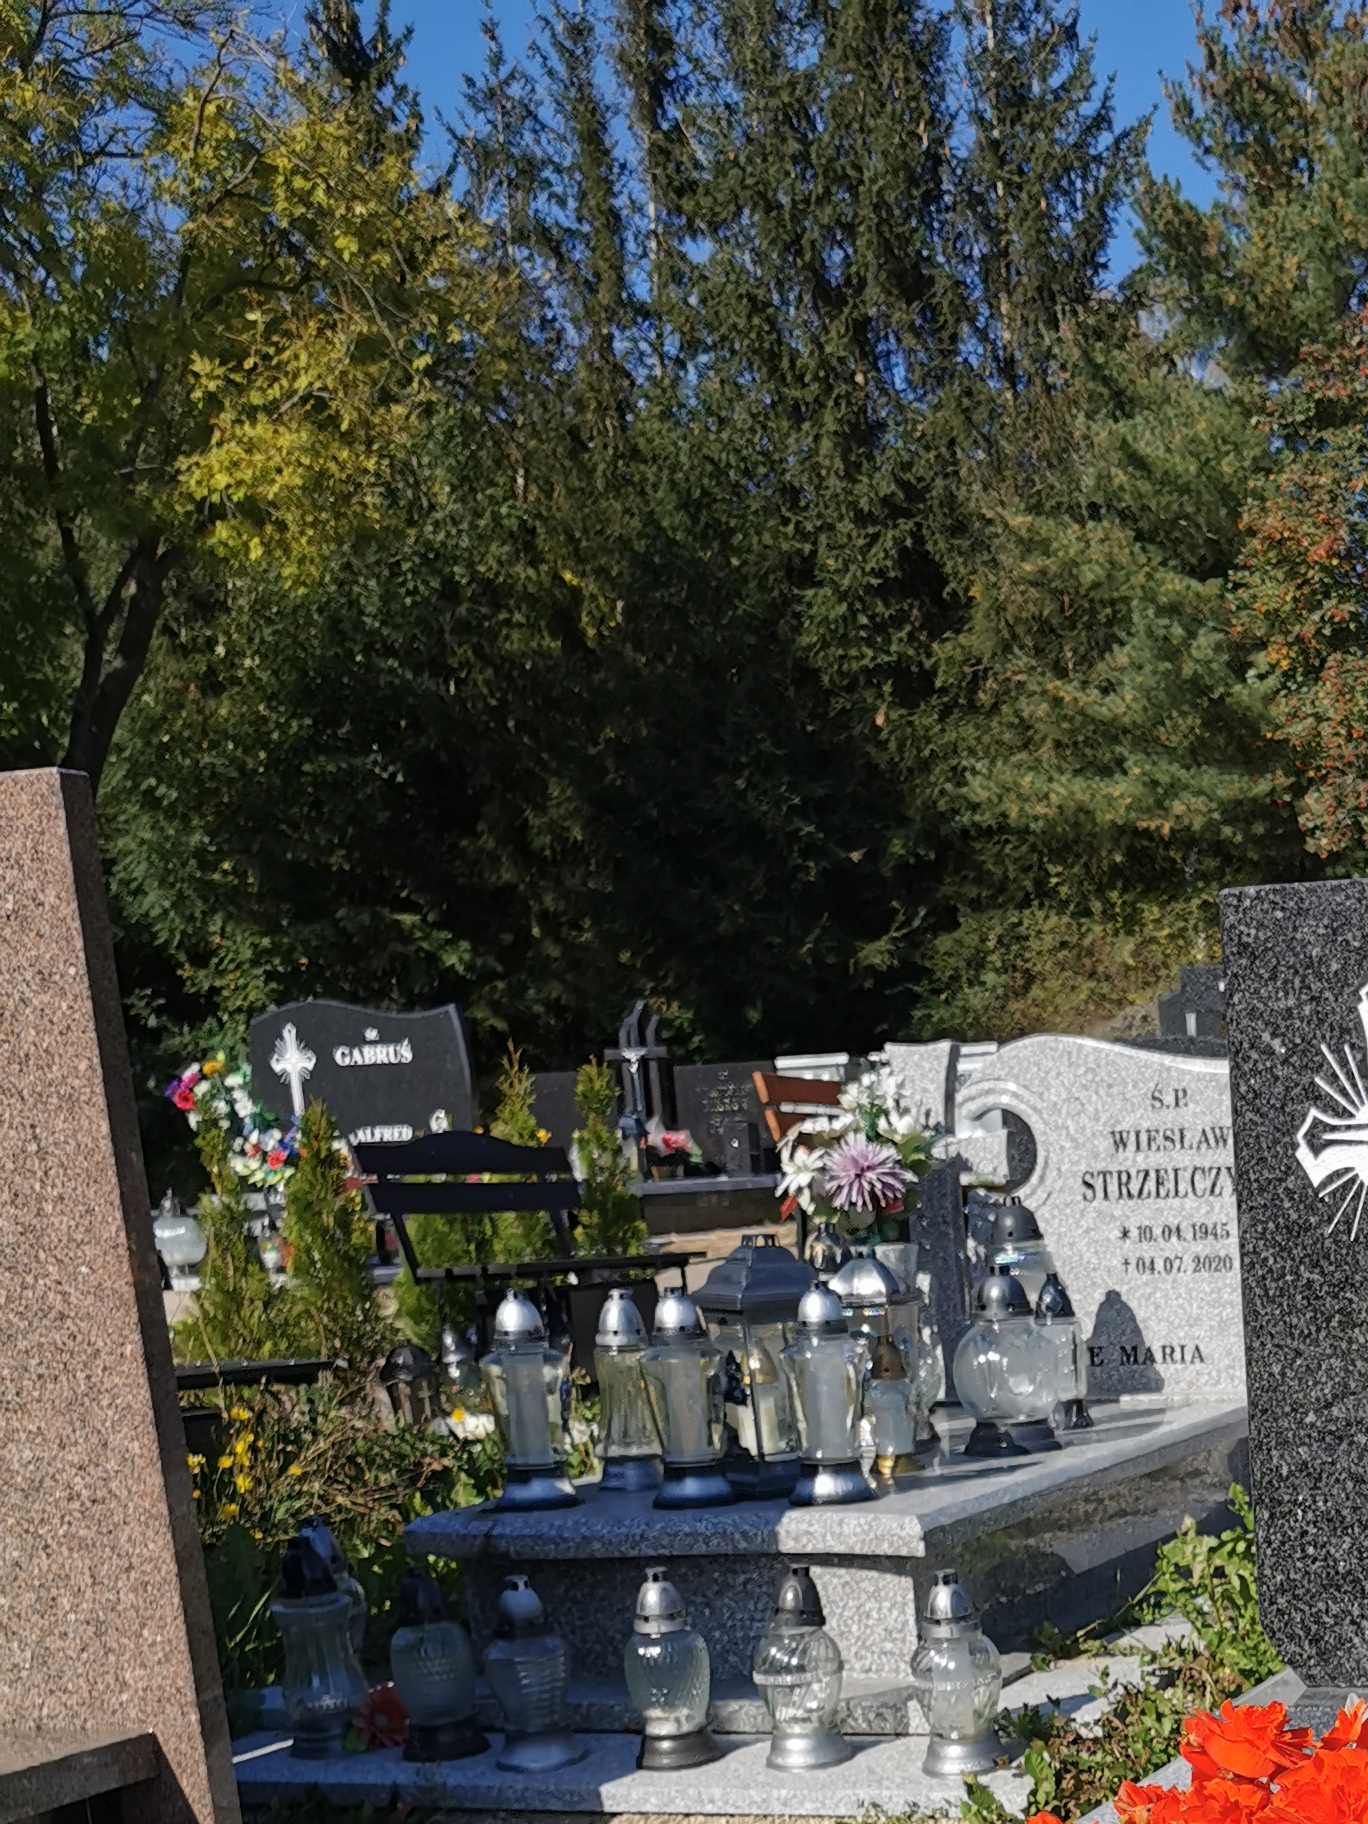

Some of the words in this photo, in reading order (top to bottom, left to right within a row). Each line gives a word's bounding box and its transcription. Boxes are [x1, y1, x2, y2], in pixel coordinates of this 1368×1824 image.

[1110, 1125, 1233, 1154] WIESŁAW
[1082, 1165, 1236, 1203] STRZELCZY
[1119, 1343, 1206, 1367] MARIA
